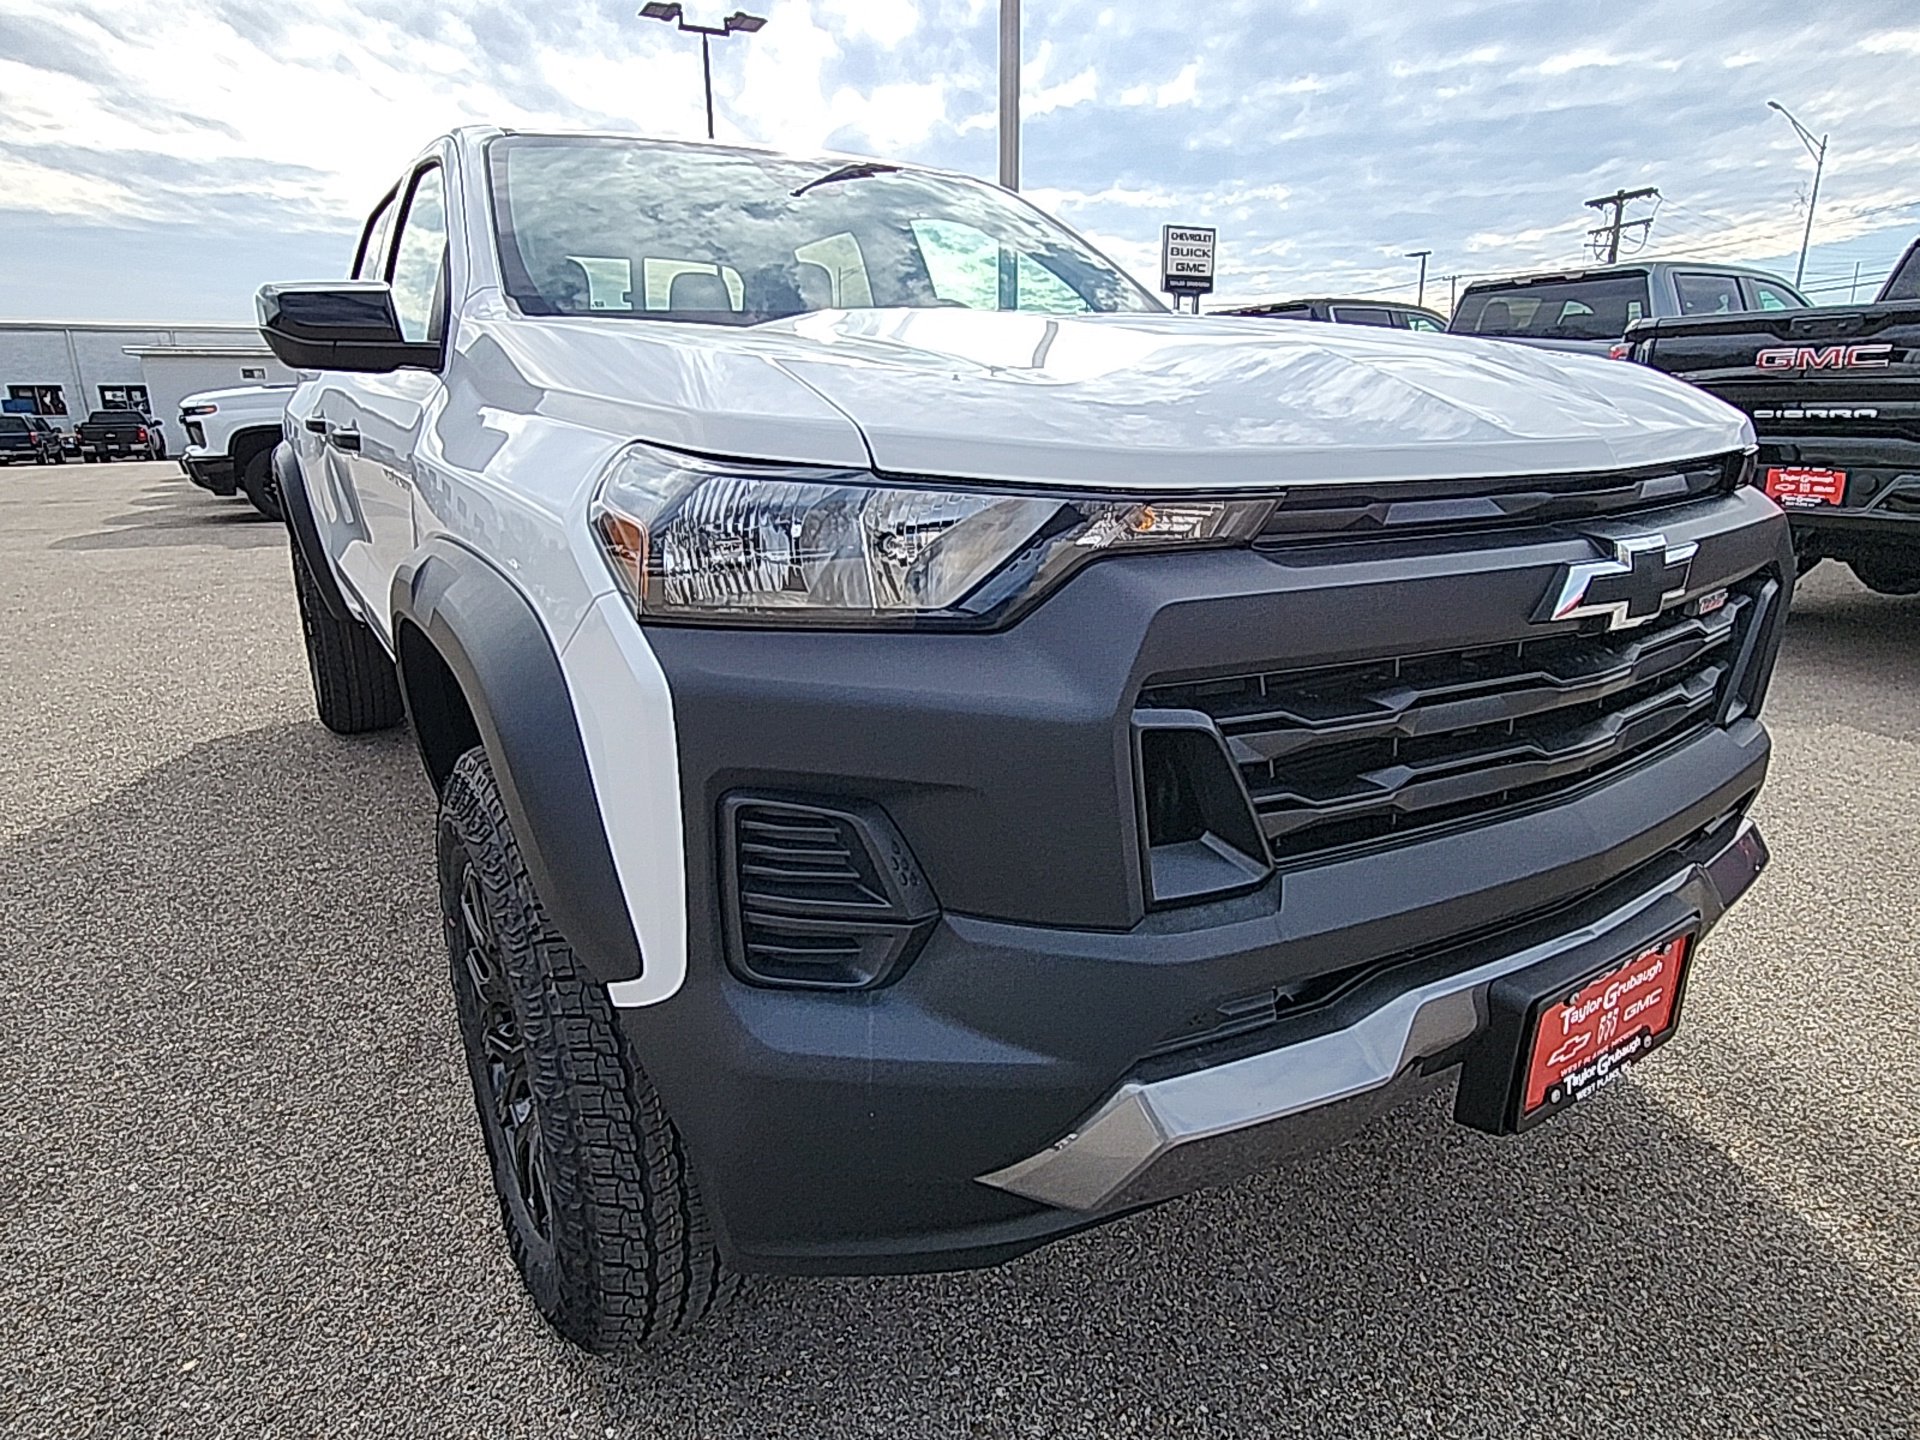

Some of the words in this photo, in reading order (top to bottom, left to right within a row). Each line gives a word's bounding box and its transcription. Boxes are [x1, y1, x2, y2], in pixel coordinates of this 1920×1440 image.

[1170, 232, 1212, 243] CHEVROLET
[1170, 246, 1211, 258] BUICK
[1175, 262, 1206, 273] GMC
[1756, 344, 1893, 371] GMC
[1754, 409, 1878, 418] SIERRA
[1560, 997, 1603, 1035] Taylor
[1602, 959, 1663, 1010] Grubaugh
[1623, 988, 1663, 1022] GMC
[1563, 1065, 1596, 1095] Taylor
[1596, 1036, 1642, 1075] Grubaugh
